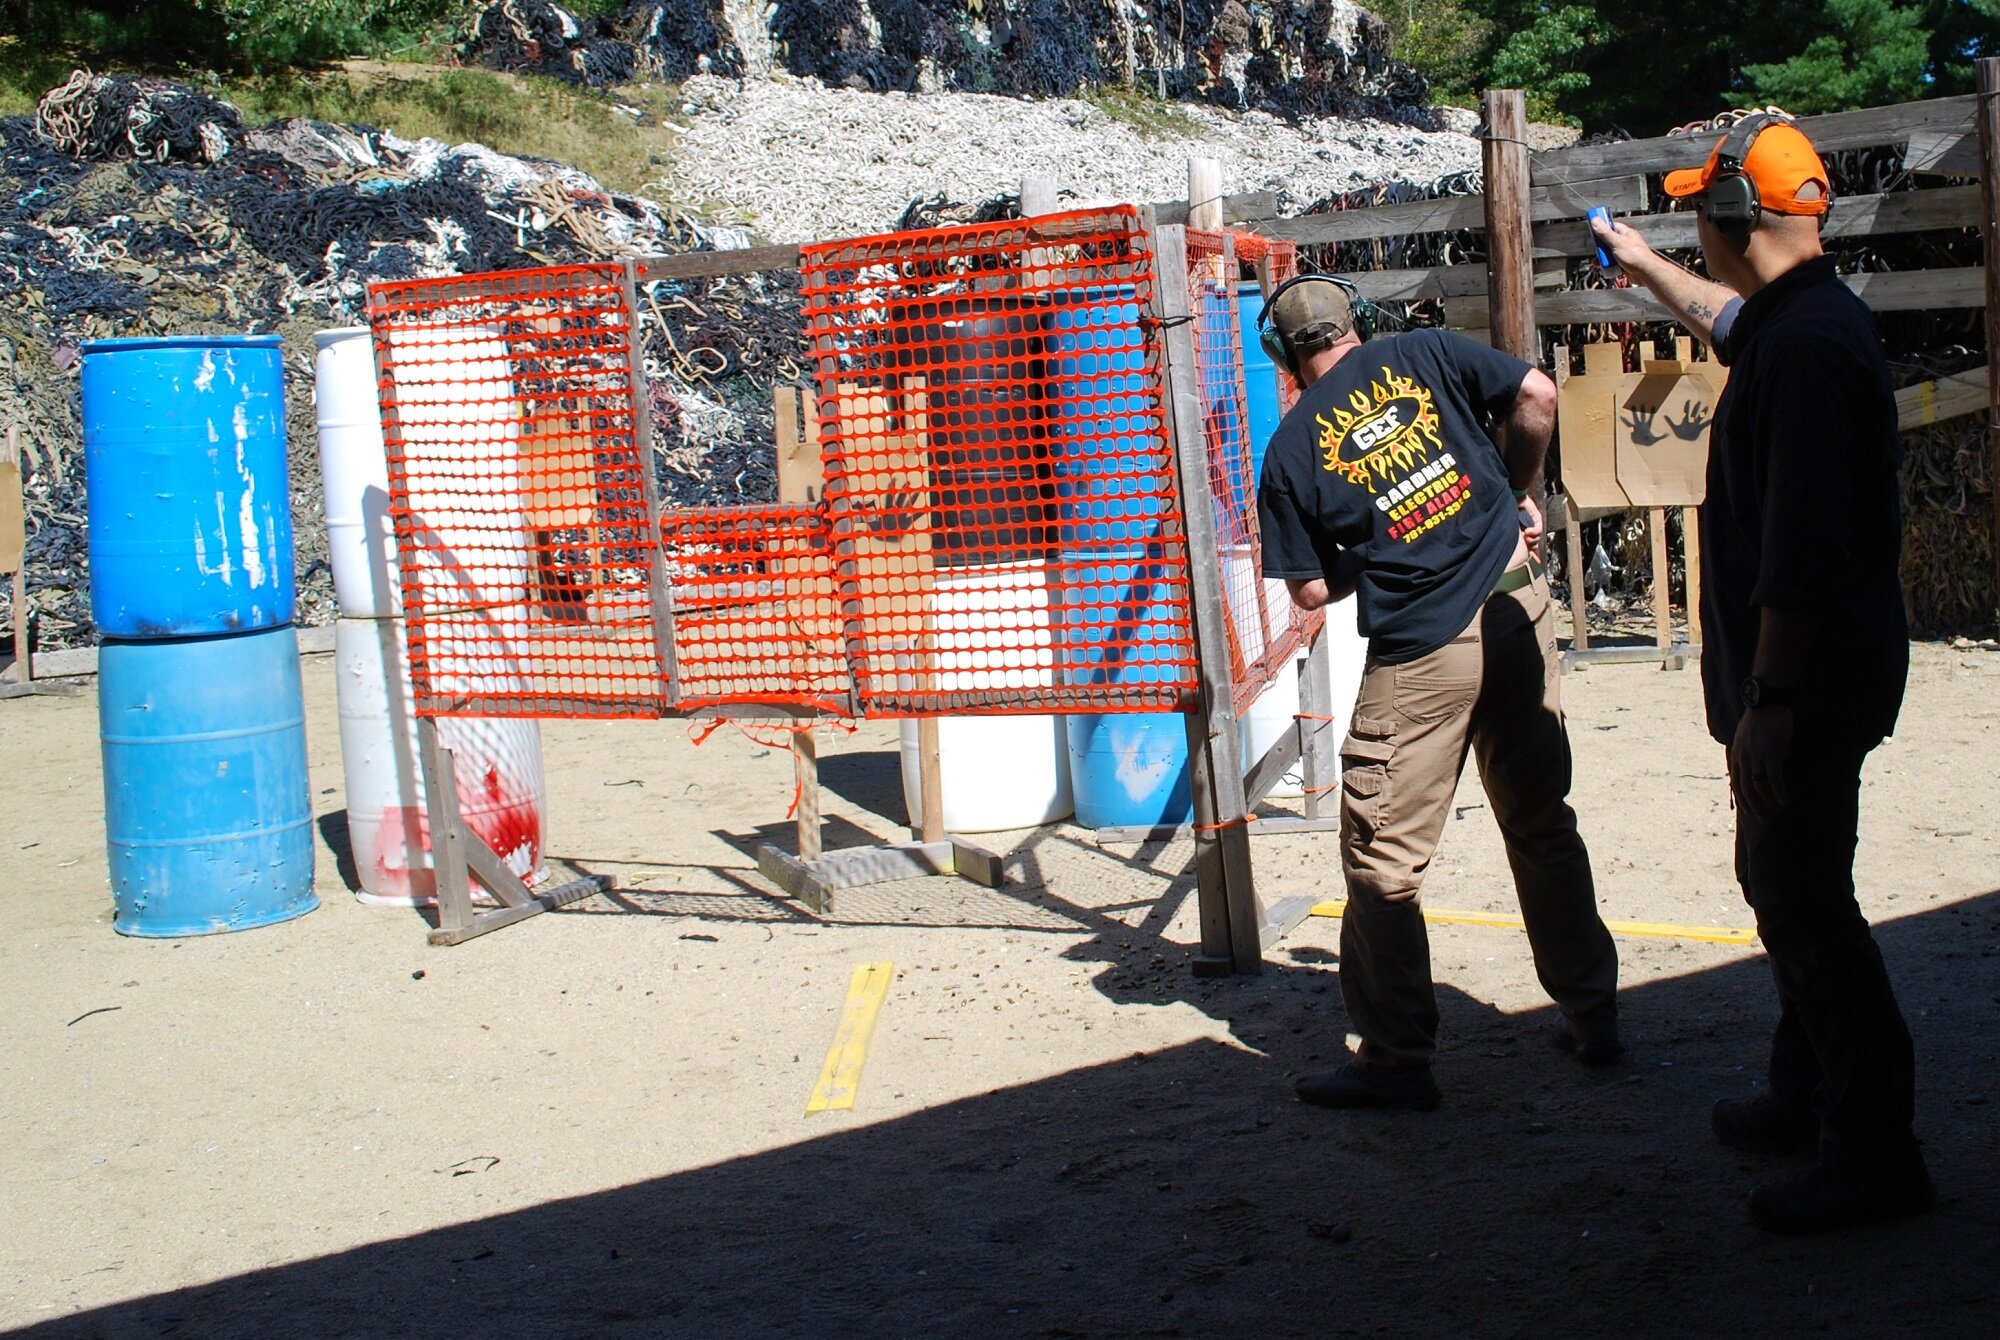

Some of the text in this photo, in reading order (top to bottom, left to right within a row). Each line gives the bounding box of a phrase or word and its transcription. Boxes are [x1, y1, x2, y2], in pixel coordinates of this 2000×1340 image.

[1672, 181, 1698, 192] STAFF
[1351, 405, 1401, 451] GEF
[1375, 453, 1457, 512] GARDNER
[1387, 473, 1472, 540] FIRE ALARM
[1388, 470, 1460, 522] ELECTRIC
